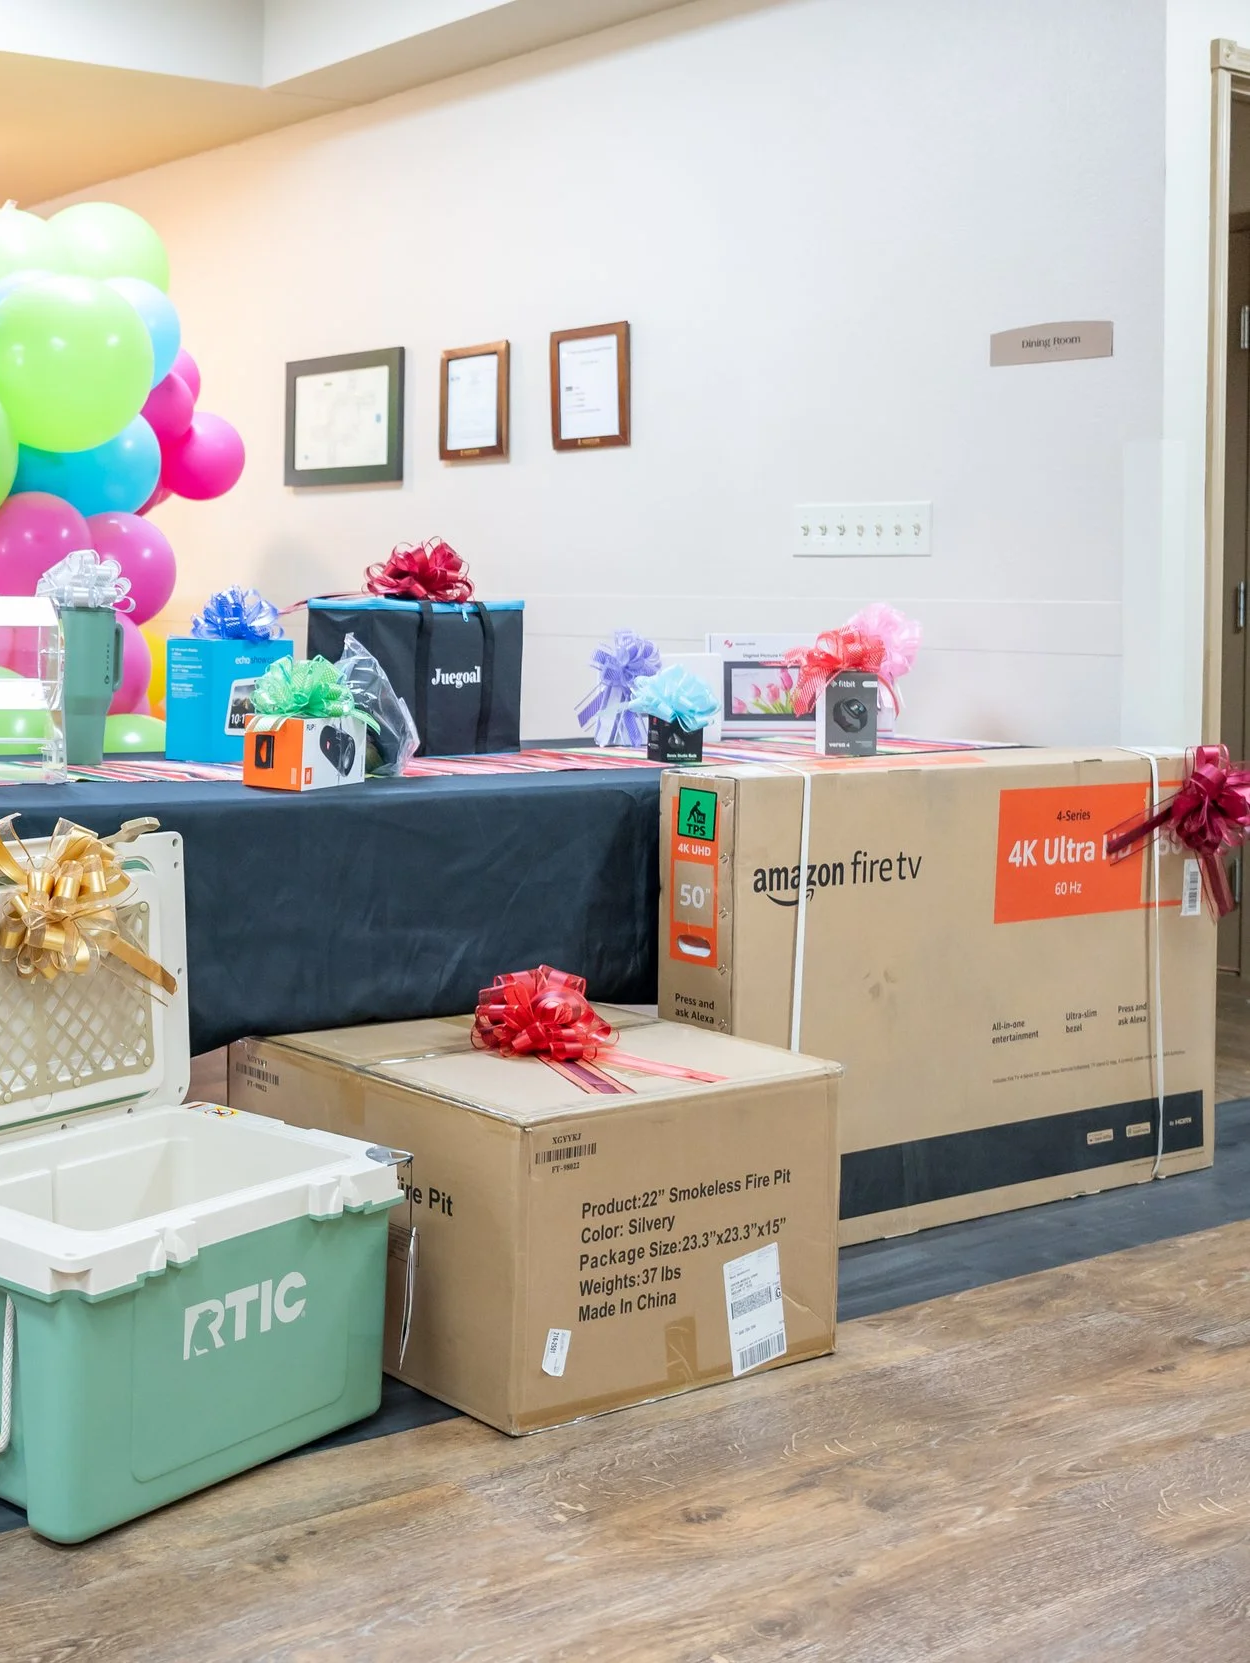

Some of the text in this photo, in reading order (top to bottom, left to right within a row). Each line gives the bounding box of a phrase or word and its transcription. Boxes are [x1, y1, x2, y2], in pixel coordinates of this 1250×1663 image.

[1021, 335, 1081, 349] Dining Room
[431, 665, 481, 689] Juegoal
[838, 680, 856, 688] fitbit
[1056, 809, 1091, 822] 4-Series
[686, 823, 706, 836] TPS
[678, 843, 711, 857] 4K UHD
[1008, 839, 1037, 868] 4K
[1043, 835, 1096, 866] Ultra
[753, 861, 845, 893] amazon
[1055, 881, 1082, 896] 60 Hz
[675, 992, 715, 1011] Press and
[1117, 1002, 1148, 1014] Press and
[675, 1008, 715, 1024] ask Alexa
[1065, 1009, 1098, 1021] Ultra-slim
[1117, 1015, 1147, 1026] ask Alexa
[992, 1020, 1025, 1031] All-in-one
[1065, 1023, 1083, 1033] bezel
[991, 1030, 1039, 1044] entertainment
[669, 1178, 742, 1203] Smokeless
[745, 1172, 770, 1190] Fire
[773, 1168, 791, 1186] Pit
[397, 1175, 453, 1217] ire Pit
[581, 1214, 676, 1244] Color: Silvery
[579, 1246, 646, 1271] Package
[660, 1264, 682, 1282] lbs
[578, 1291, 677, 1322] Made In China
[183, 1271, 307, 1361] RTIC
